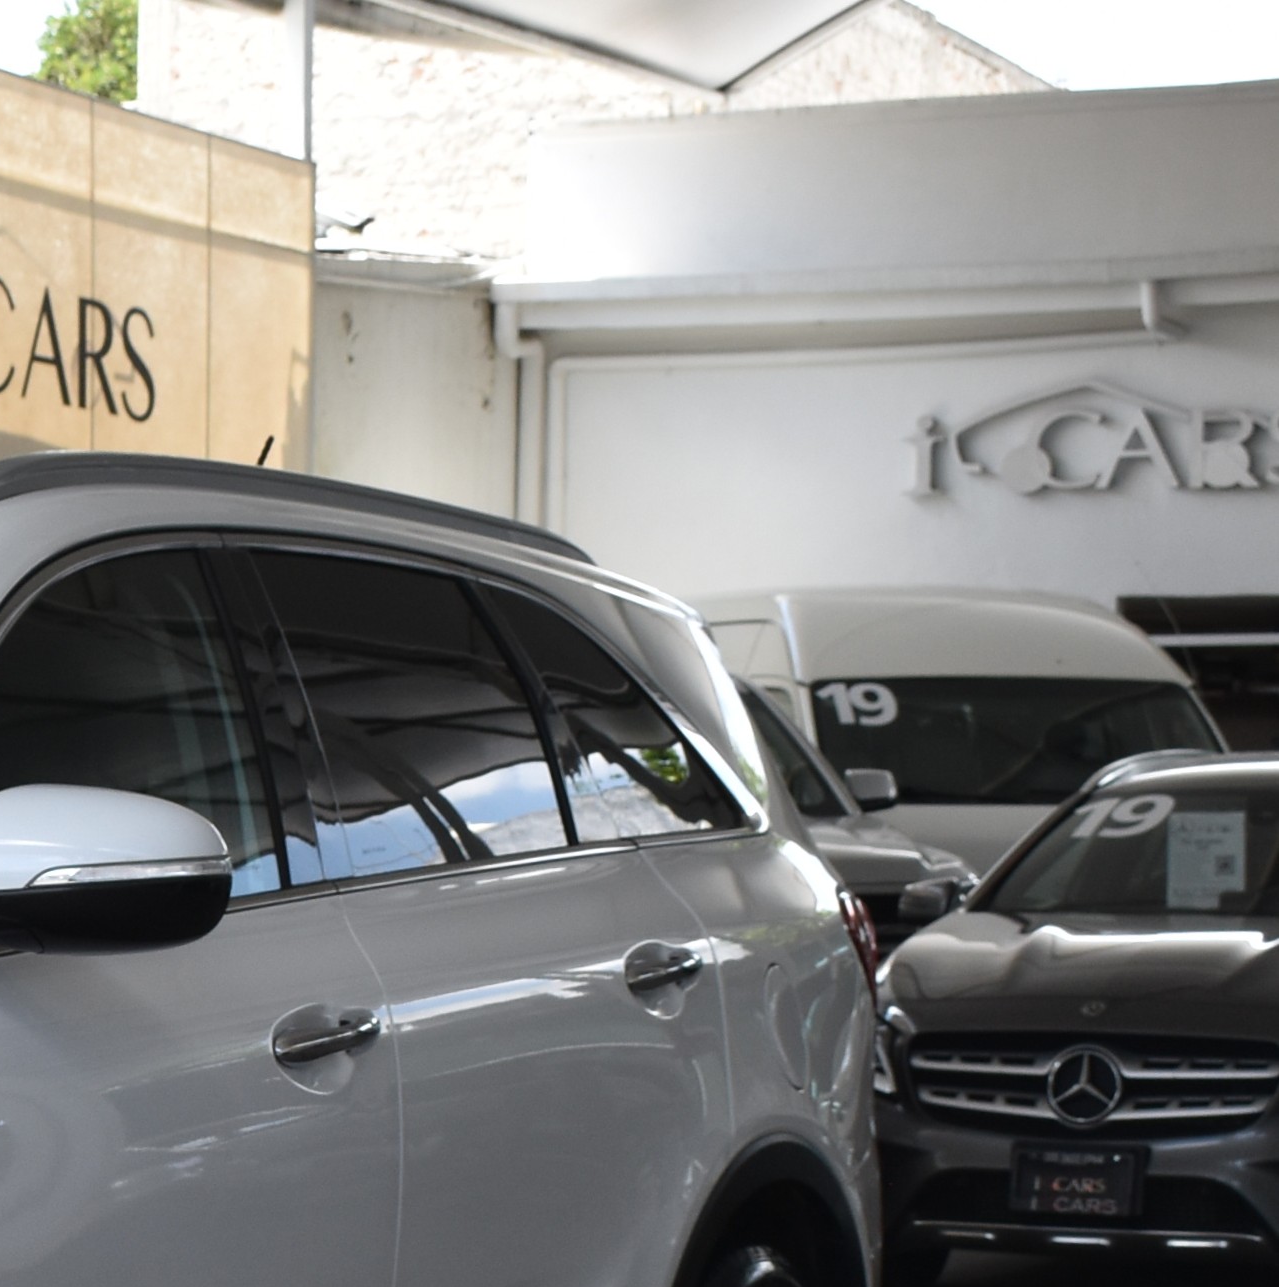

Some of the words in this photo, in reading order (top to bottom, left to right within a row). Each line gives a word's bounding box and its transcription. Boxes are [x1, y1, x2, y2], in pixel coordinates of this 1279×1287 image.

[1039, 402, 1279, 489] CAR
[816, 683, 898, 726] 19
[1071, 794, 1175, 837] 19
[1052, 1196, 1118, 1215] CARS
[1053, 1177, 1105, 1193] CARS
